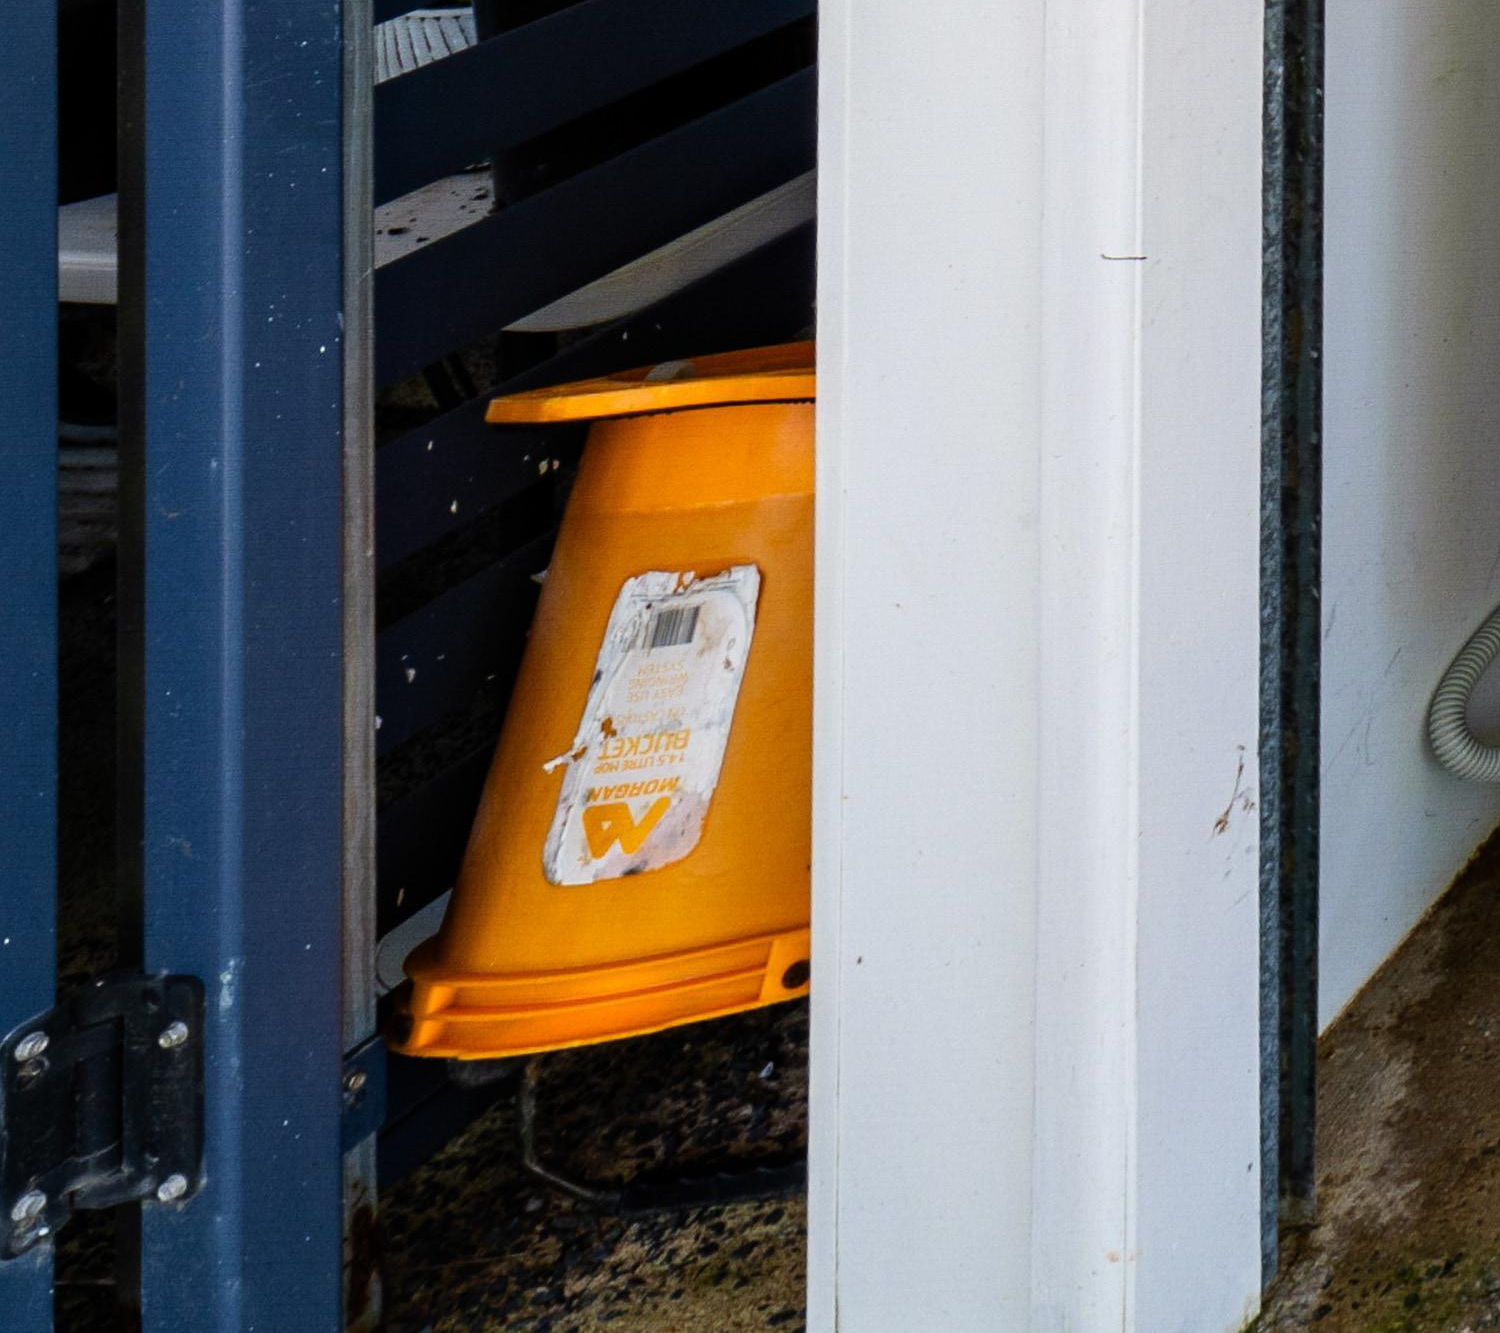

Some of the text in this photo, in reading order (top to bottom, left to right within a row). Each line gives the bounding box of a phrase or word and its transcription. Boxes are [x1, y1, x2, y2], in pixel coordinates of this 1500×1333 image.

[598, 727, 691, 760] BUCKET
[593, 760, 620, 775] MOP
[623, 757, 655, 771] LITRE
[586, 776, 681, 803] MORGAN
